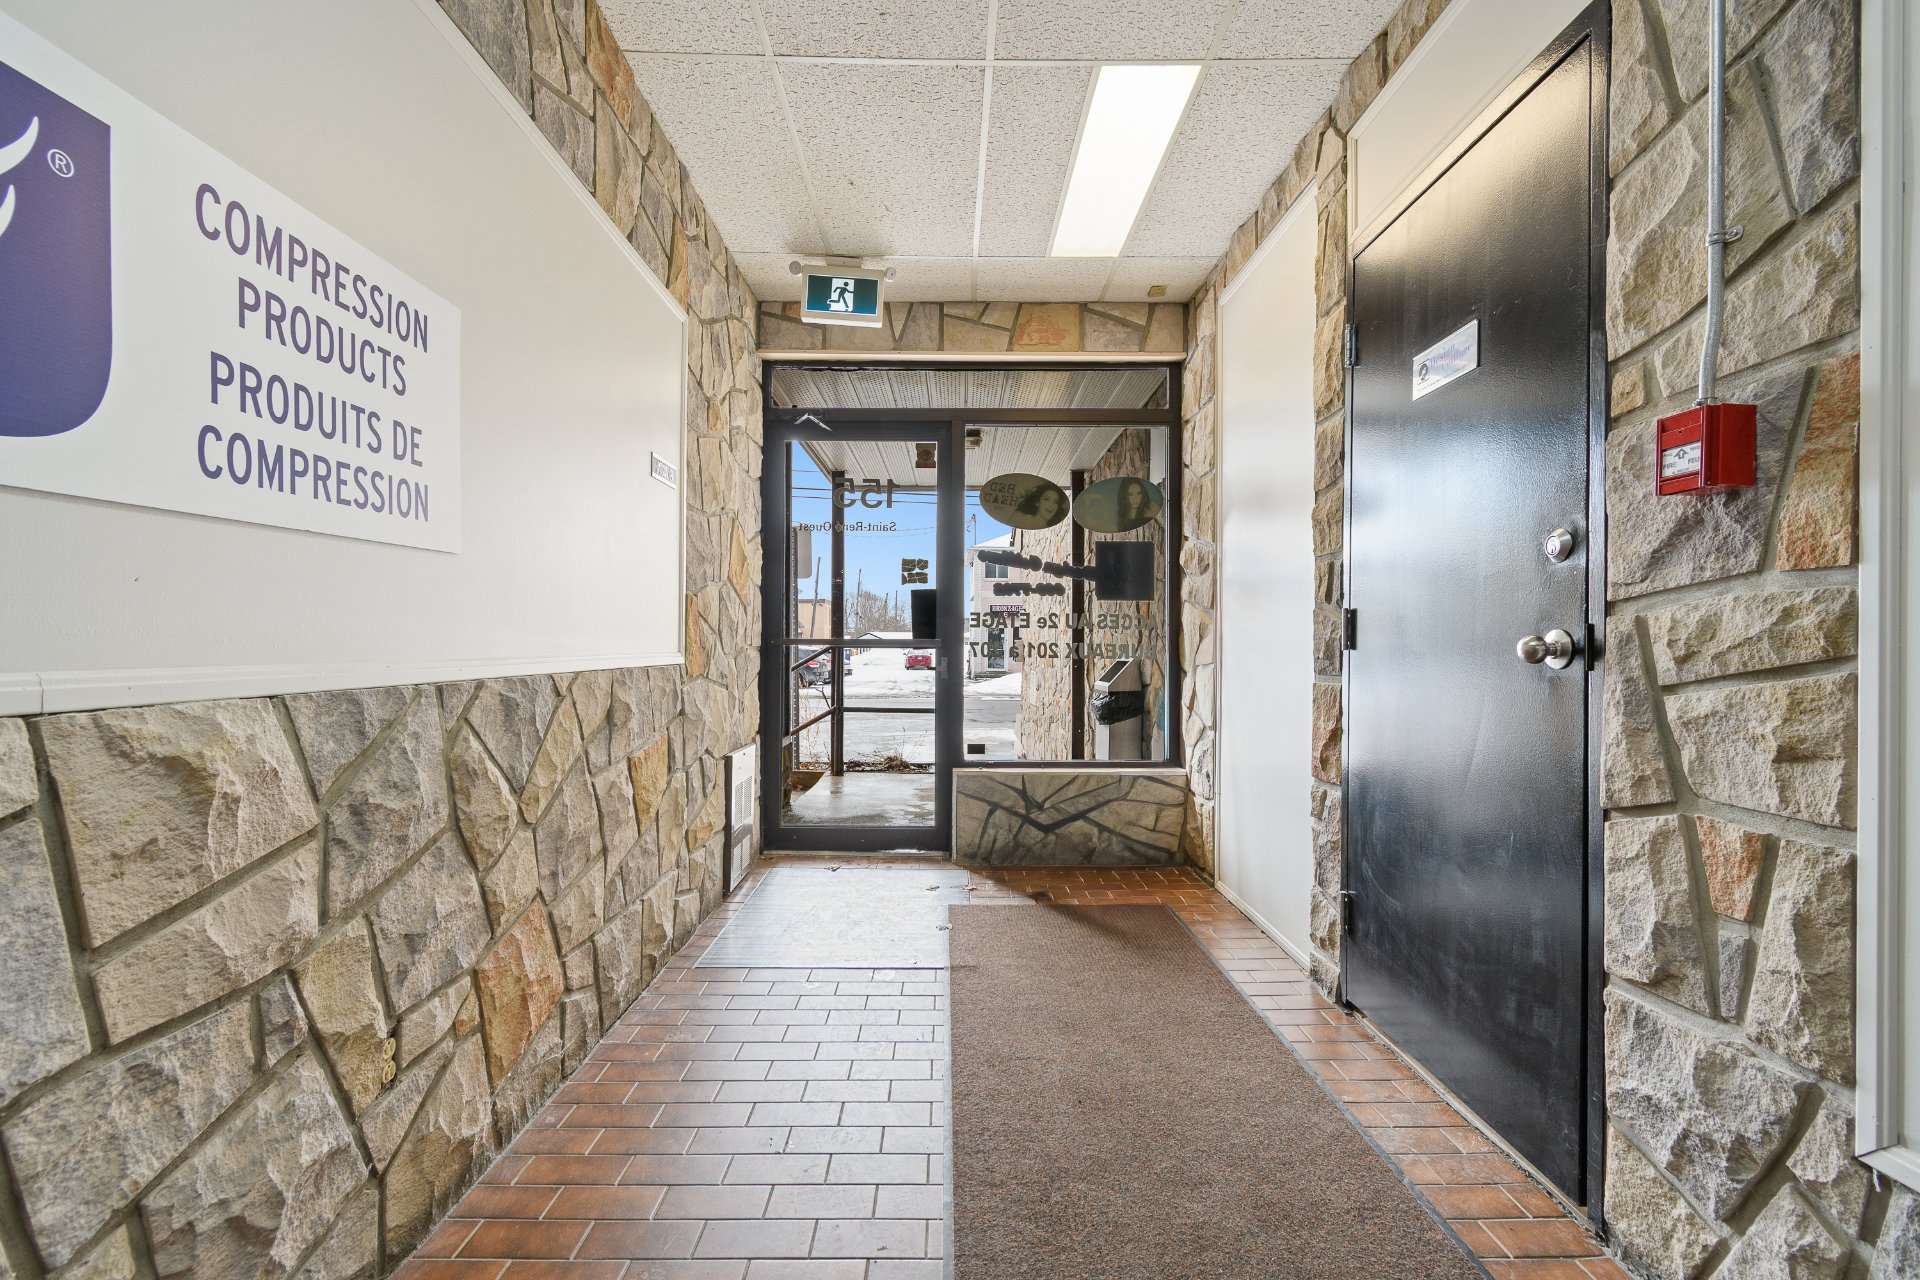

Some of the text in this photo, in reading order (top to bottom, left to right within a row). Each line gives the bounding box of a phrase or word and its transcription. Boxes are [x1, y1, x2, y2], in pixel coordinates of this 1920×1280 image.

[195, 183, 428, 353] COMPRESSION
[238, 277, 407, 396] PRODUCTS
[210, 351, 423, 468] PRODUITS DE
[197, 424, 429, 523] COMPRESSION
